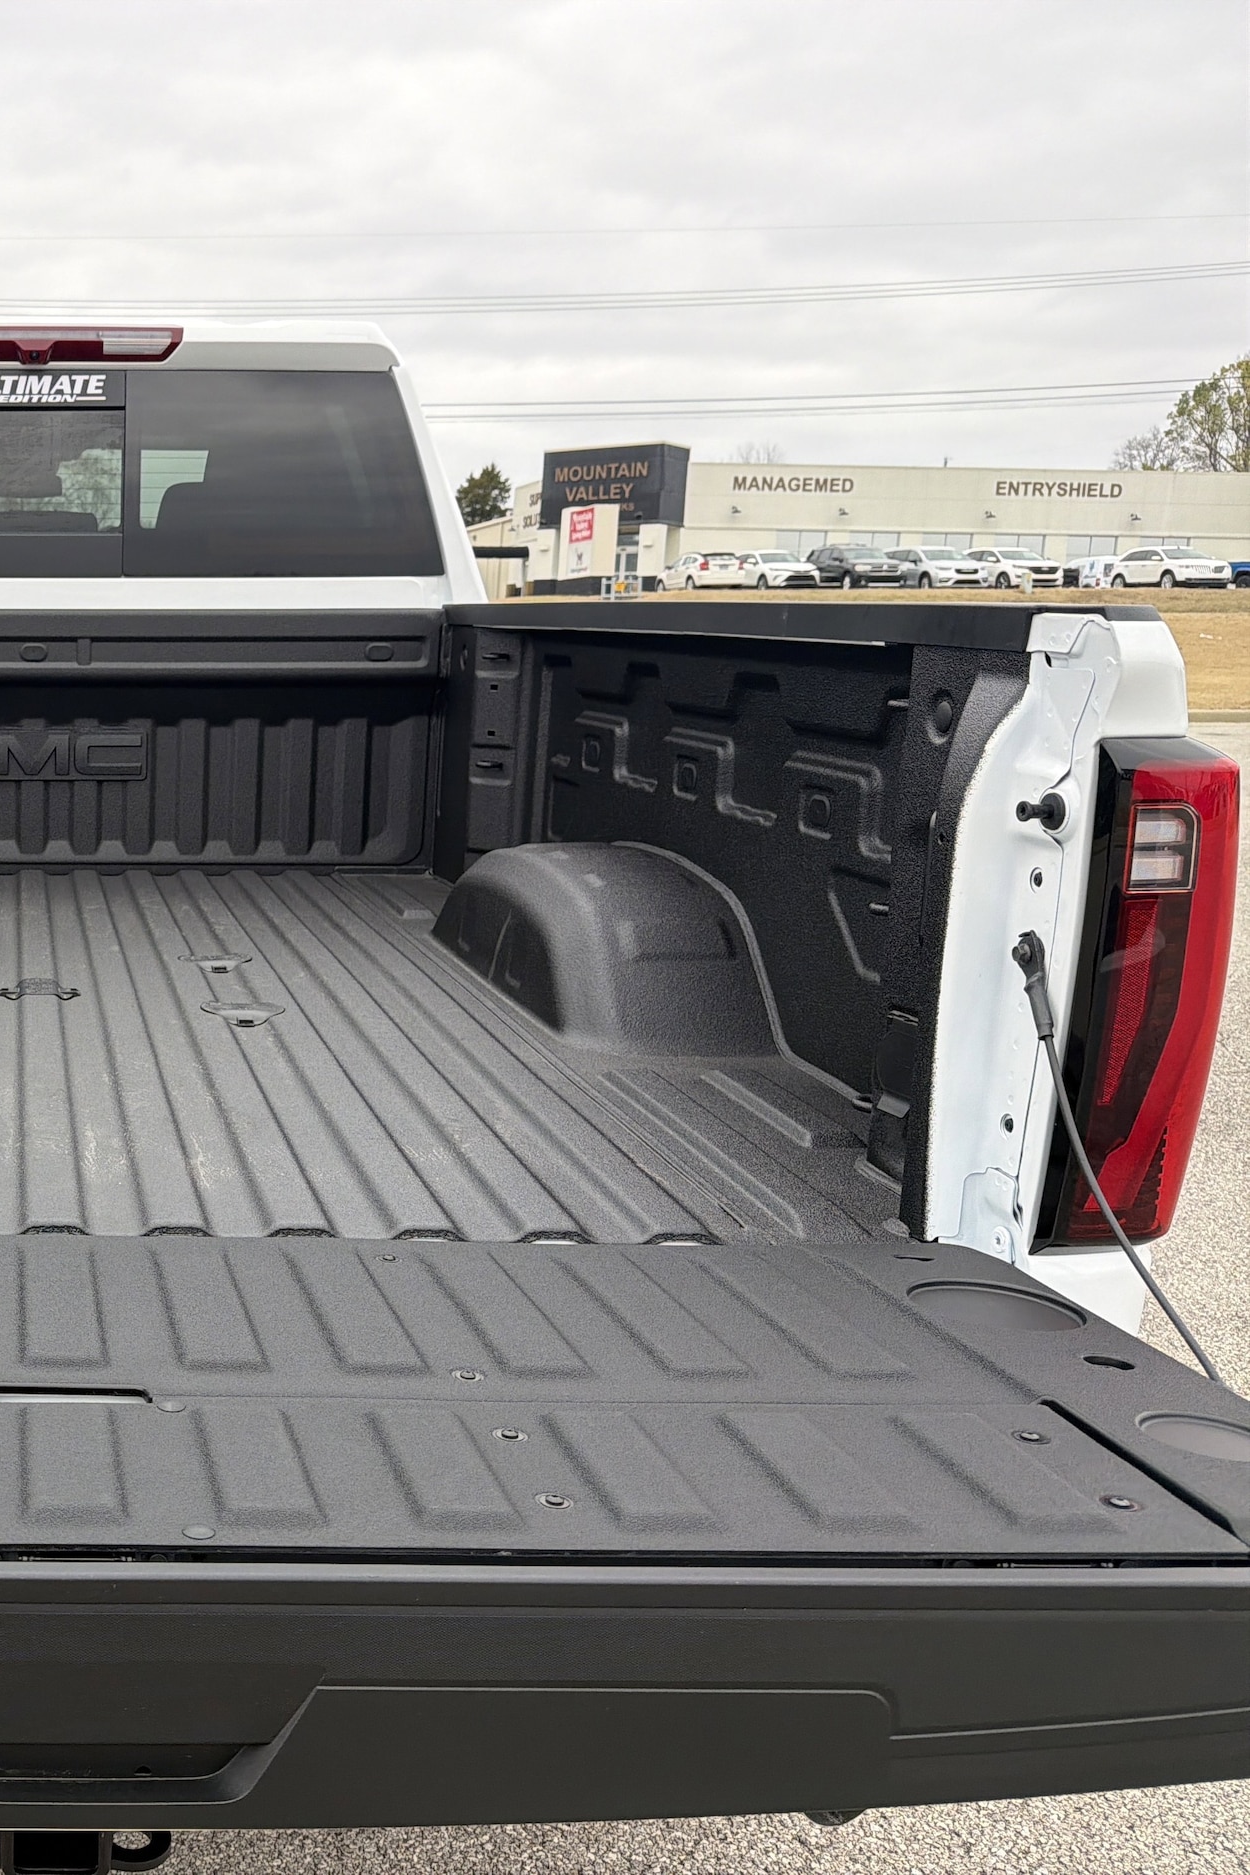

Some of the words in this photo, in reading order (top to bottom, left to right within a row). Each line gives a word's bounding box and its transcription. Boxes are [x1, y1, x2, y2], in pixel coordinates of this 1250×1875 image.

[554, 461, 648, 483] MOUNTAIN
[565, 483, 634, 502] VALLEY
[732, 476, 854, 493] MANAGEMED
[995, 481, 1123, 498] ENTRYSHIELD
